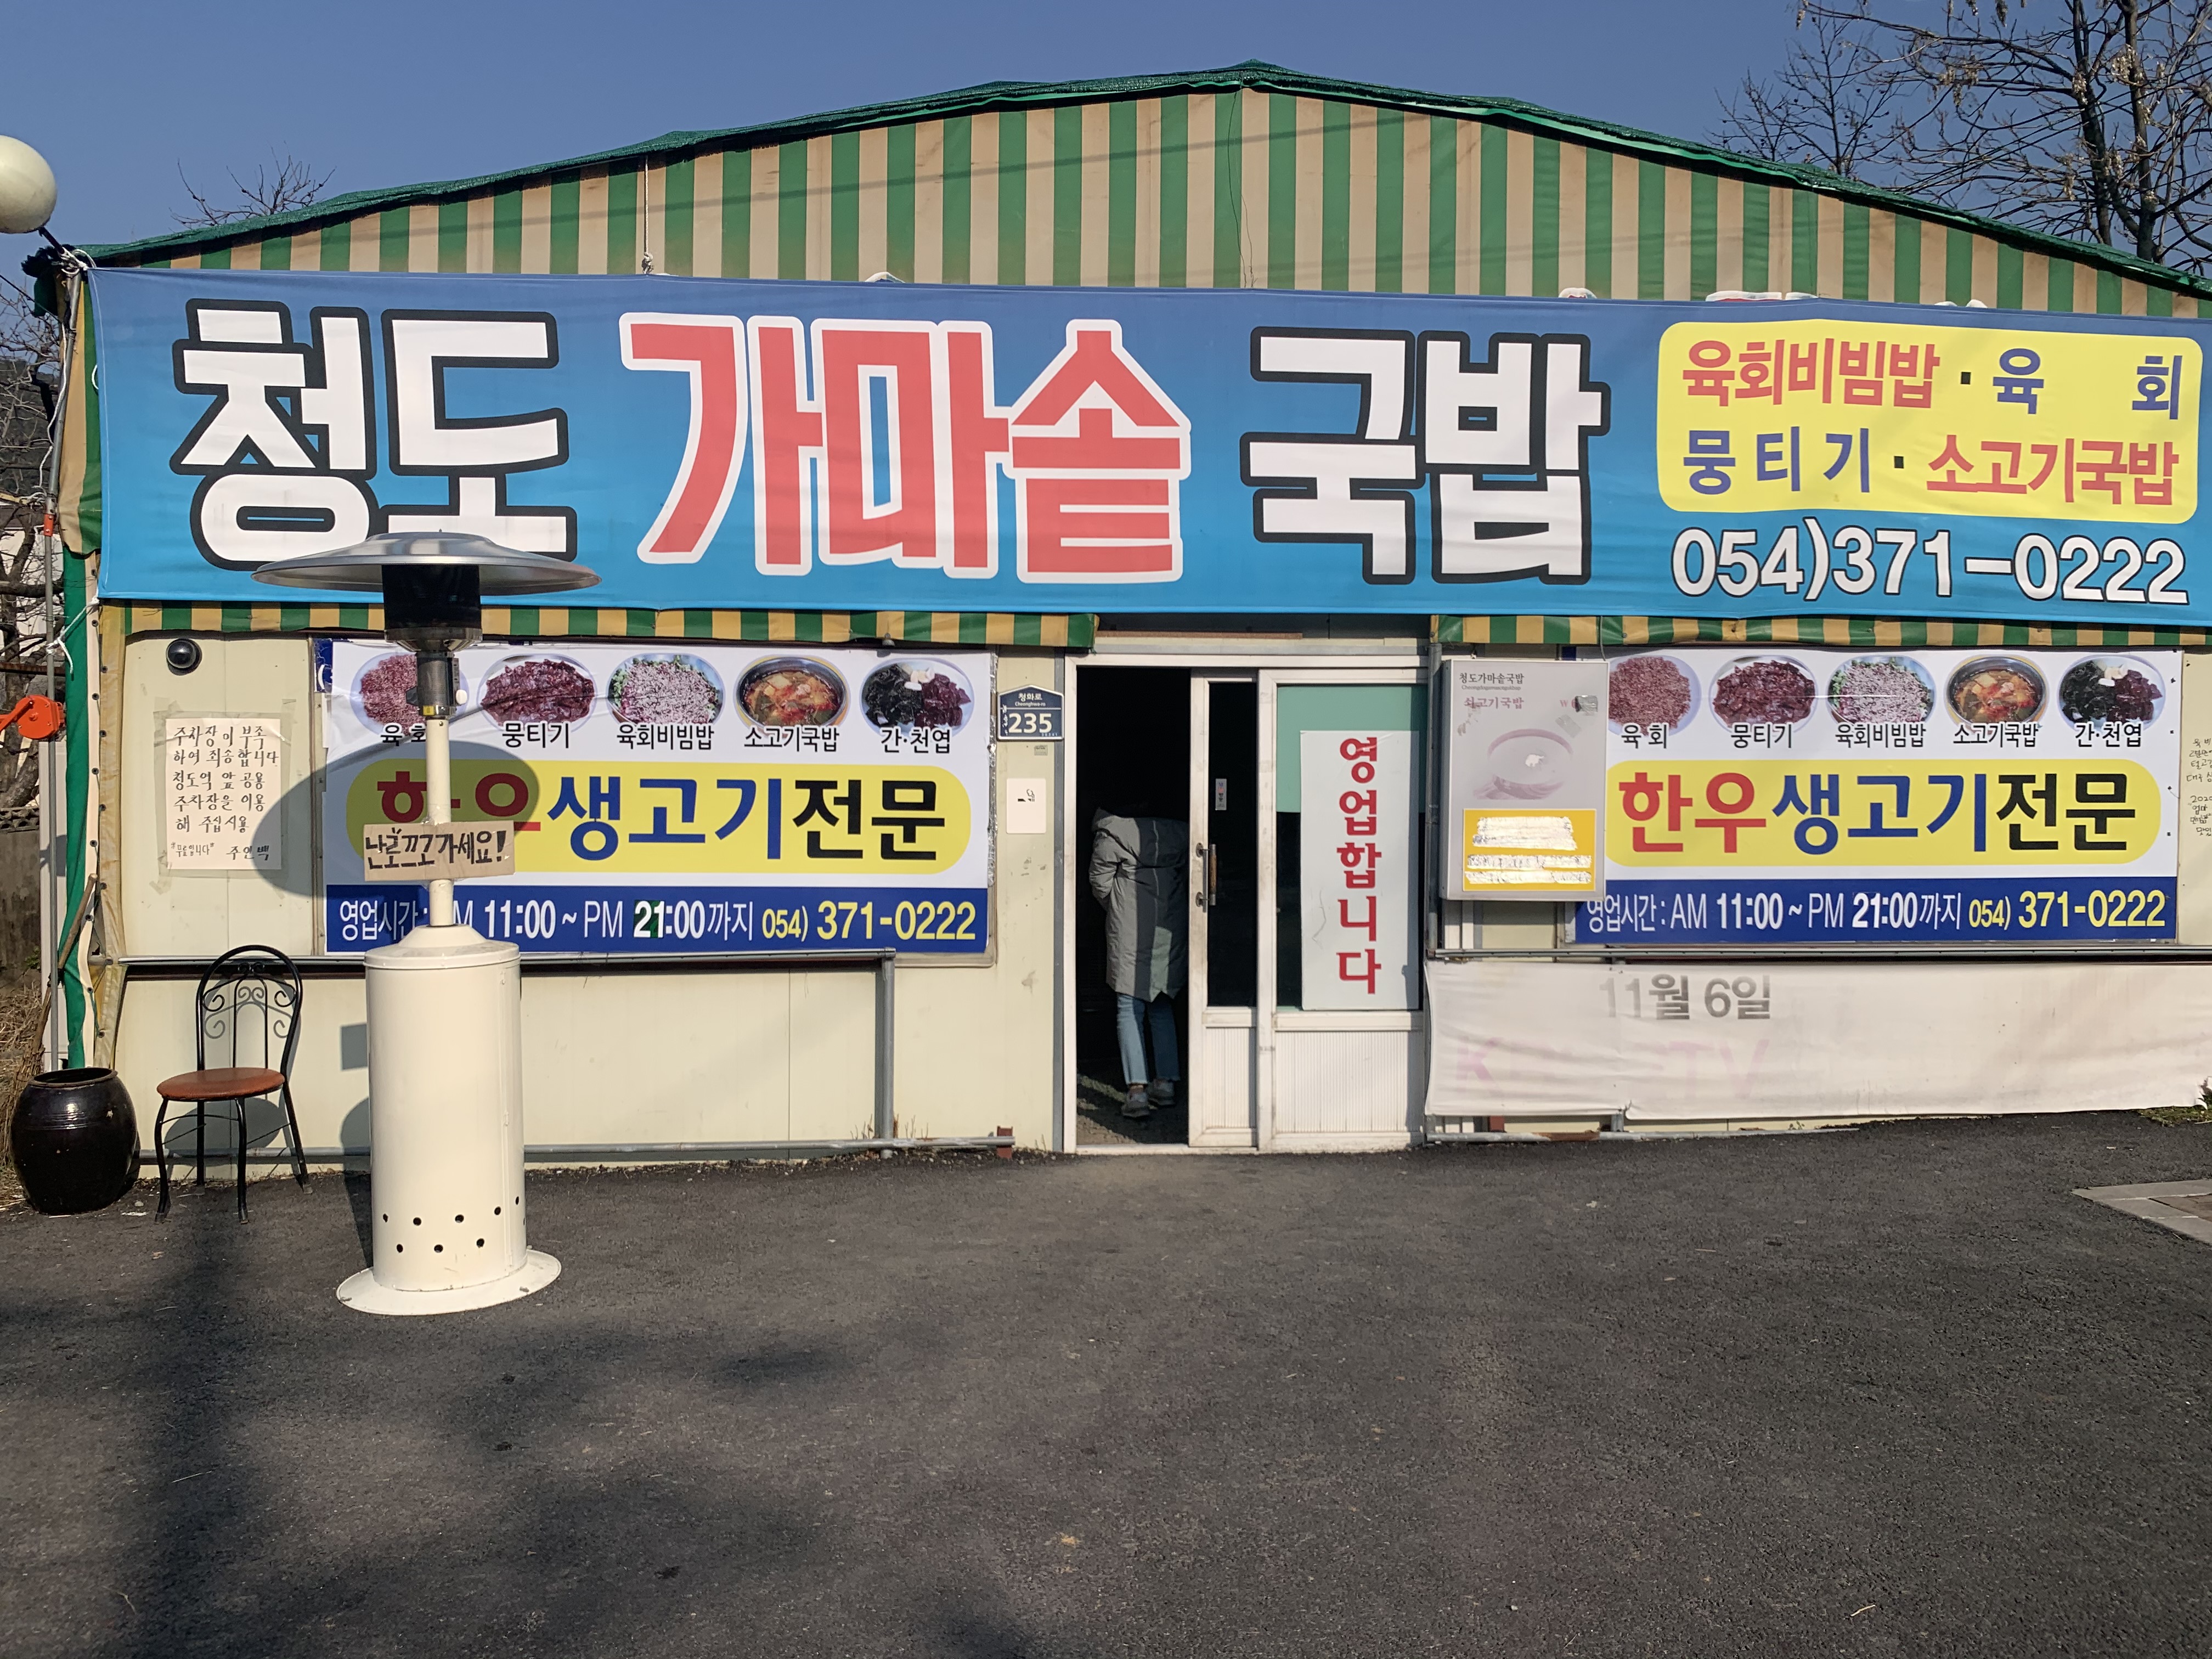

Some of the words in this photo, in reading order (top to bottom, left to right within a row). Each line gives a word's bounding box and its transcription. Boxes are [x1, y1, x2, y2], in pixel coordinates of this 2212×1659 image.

[1682, 338, 1940, 408] 육회비빔밥
[170, 298, 577, 571] 청도
[619, 312, 1191, 584] 가마솥
[1240, 326, 1611, 584] 국밥
[1926, 435, 2179, 506] 소고기국밥
[1459, 673, 1525, 684] 청도가마솥국밥
[1018, 693, 1042, 702] 청화로
[502, 722, 570, 748] 뭉티기
[1008, 713, 1052, 733] 235
[1835, 723, 1926, 747] 육회비빔밥
[1953, 723, 2039, 747] 소고기국밥
[239, 725, 267, 750] 부족
[616, 722, 715, 750] 육회비빔밥
[744, 726, 839, 753] 소고기국밥
[1730, 724, 1792, 748] 뭉티기
[173, 749, 200, 765] 하여
[173, 770, 211, 791] 청도역
[220, 771, 235, 789] 앞
[240, 772, 266, 790] 공용
[173, 793, 234, 812] 주차장을
[241, 793, 266, 812] 이용
[176, 815, 190, 833] 해
[1336, 737, 1382, 995] 영업합니다
[584, 900, 623, 938] PM
[1809, 893, 1844, 929] PM
[1599, 974, 1690, 1020] 11월
[1705, 974, 1771, 1019] 6일
